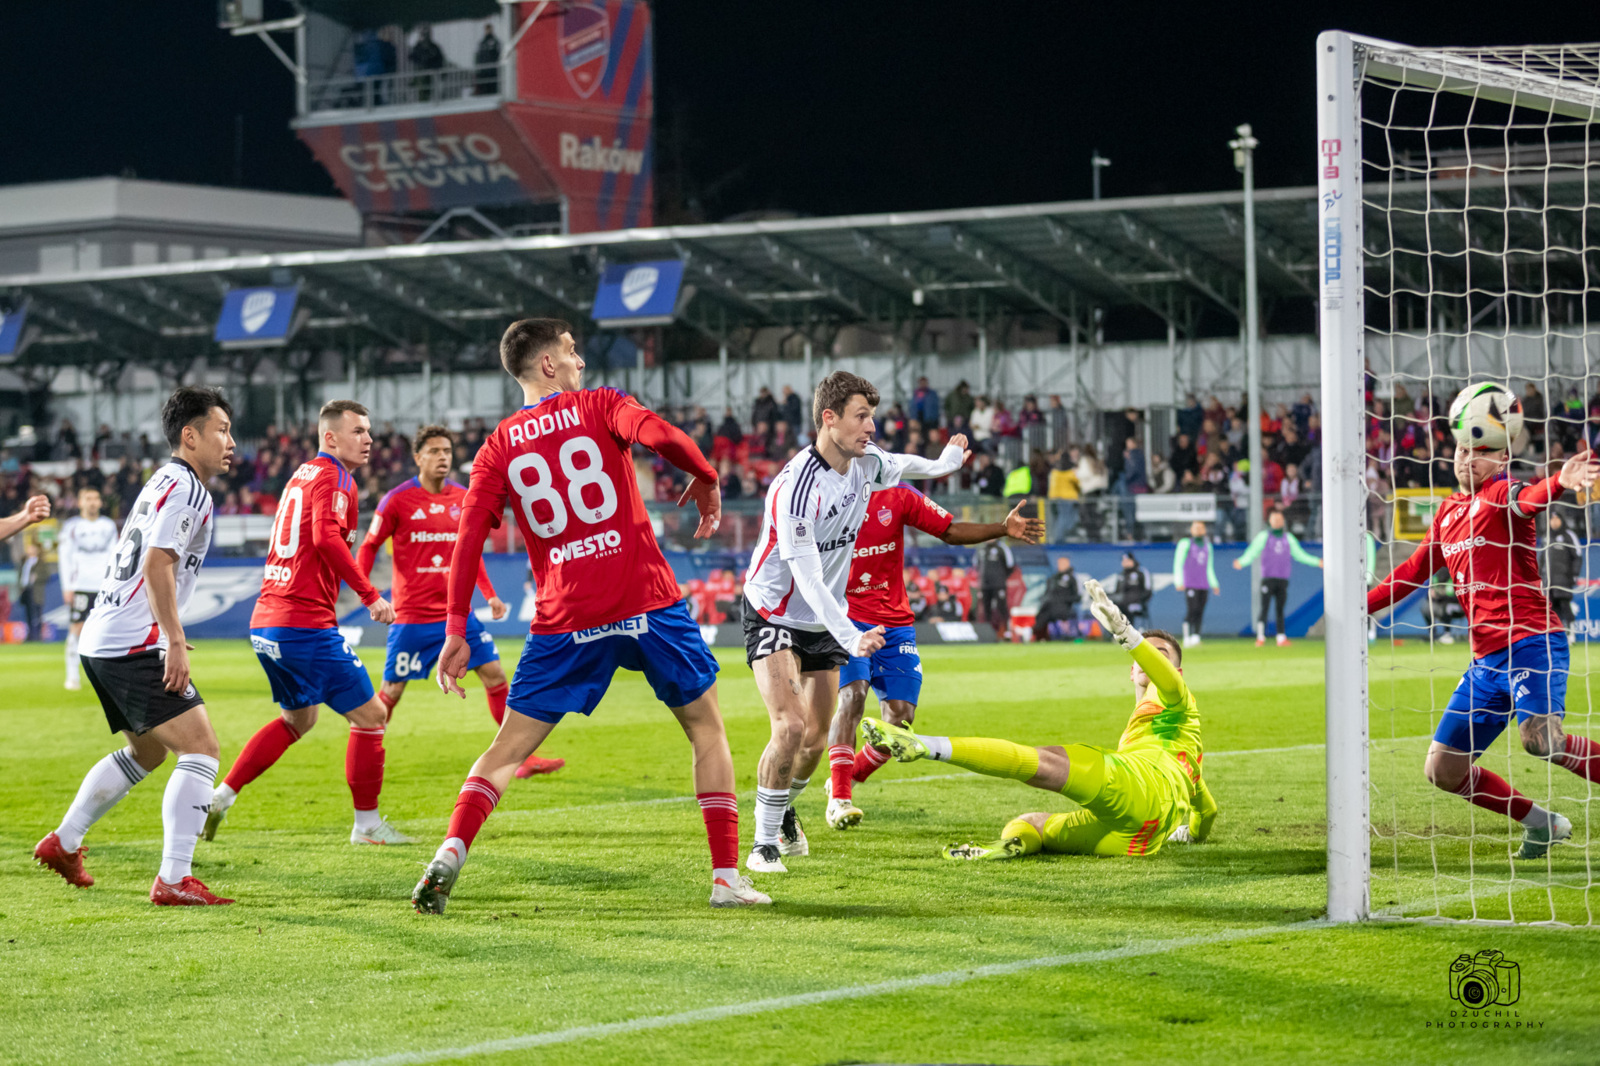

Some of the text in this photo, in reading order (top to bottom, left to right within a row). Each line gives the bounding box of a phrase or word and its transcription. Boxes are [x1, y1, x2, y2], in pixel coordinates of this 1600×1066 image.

[560, 132, 644, 175] Raków
[508, 405, 582, 447] RODIN
[507, 435, 618, 539] 88
[410, 531, 460, 543] Hisens
[549, 529, 622, 565] ONESTO
[851, 541, 897, 559] sense
[594, 547, 623, 560] ENERGY
[576, 616, 643, 640] NEONET
[756, 626, 793, 657] 28
[342, 640, 363, 668] 3
[394, 651, 423, 677] 84
[898, 645, 920, 657] FRU
